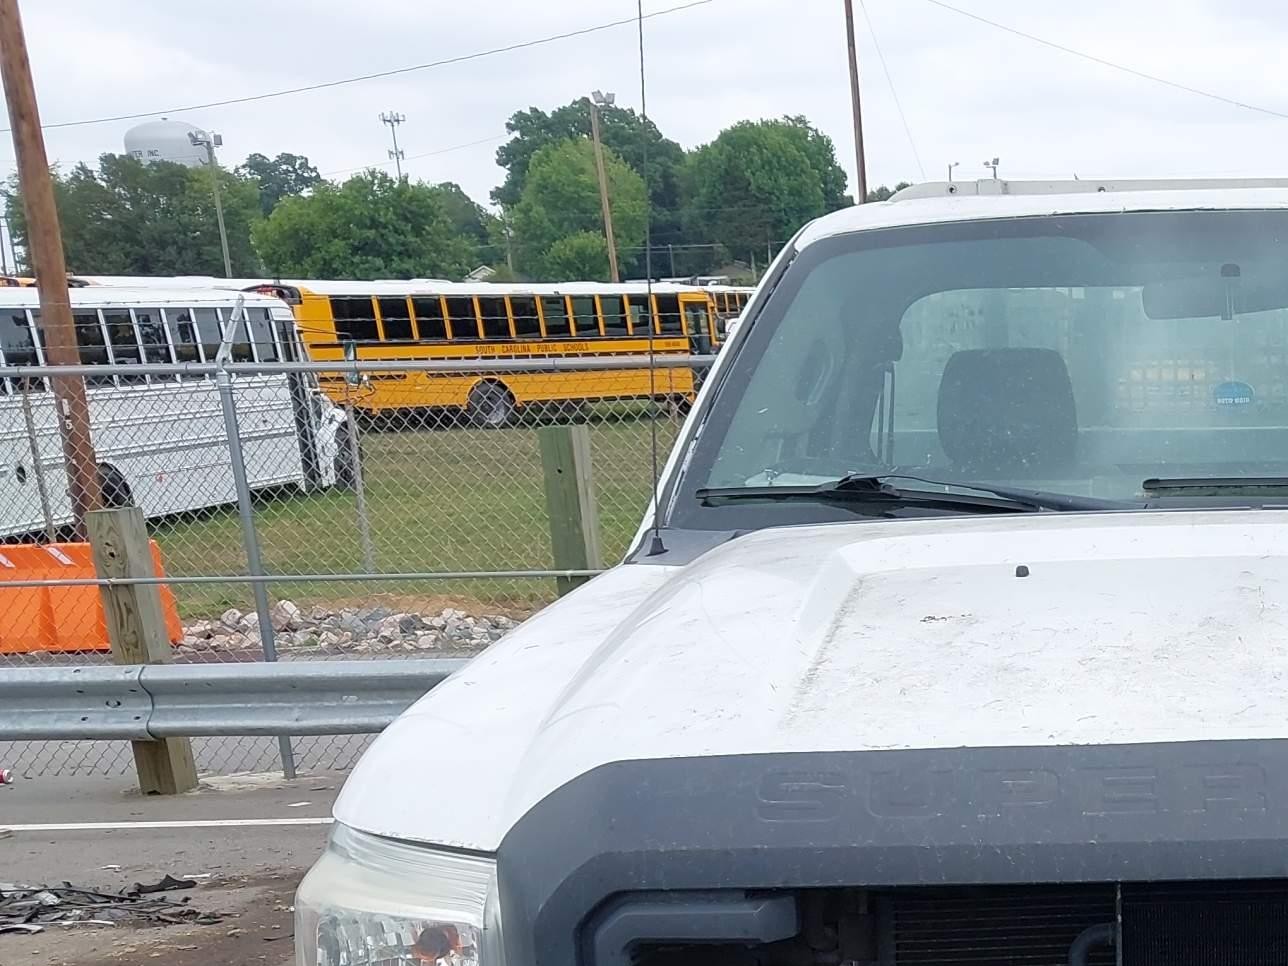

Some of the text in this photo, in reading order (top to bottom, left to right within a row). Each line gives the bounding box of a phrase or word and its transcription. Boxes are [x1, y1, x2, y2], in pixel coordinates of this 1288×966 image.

[475, 342, 589, 354] SOUTH CAROLINA PUBLIC SCHOOLS
[755, 763, 1267, 823] SUPER
